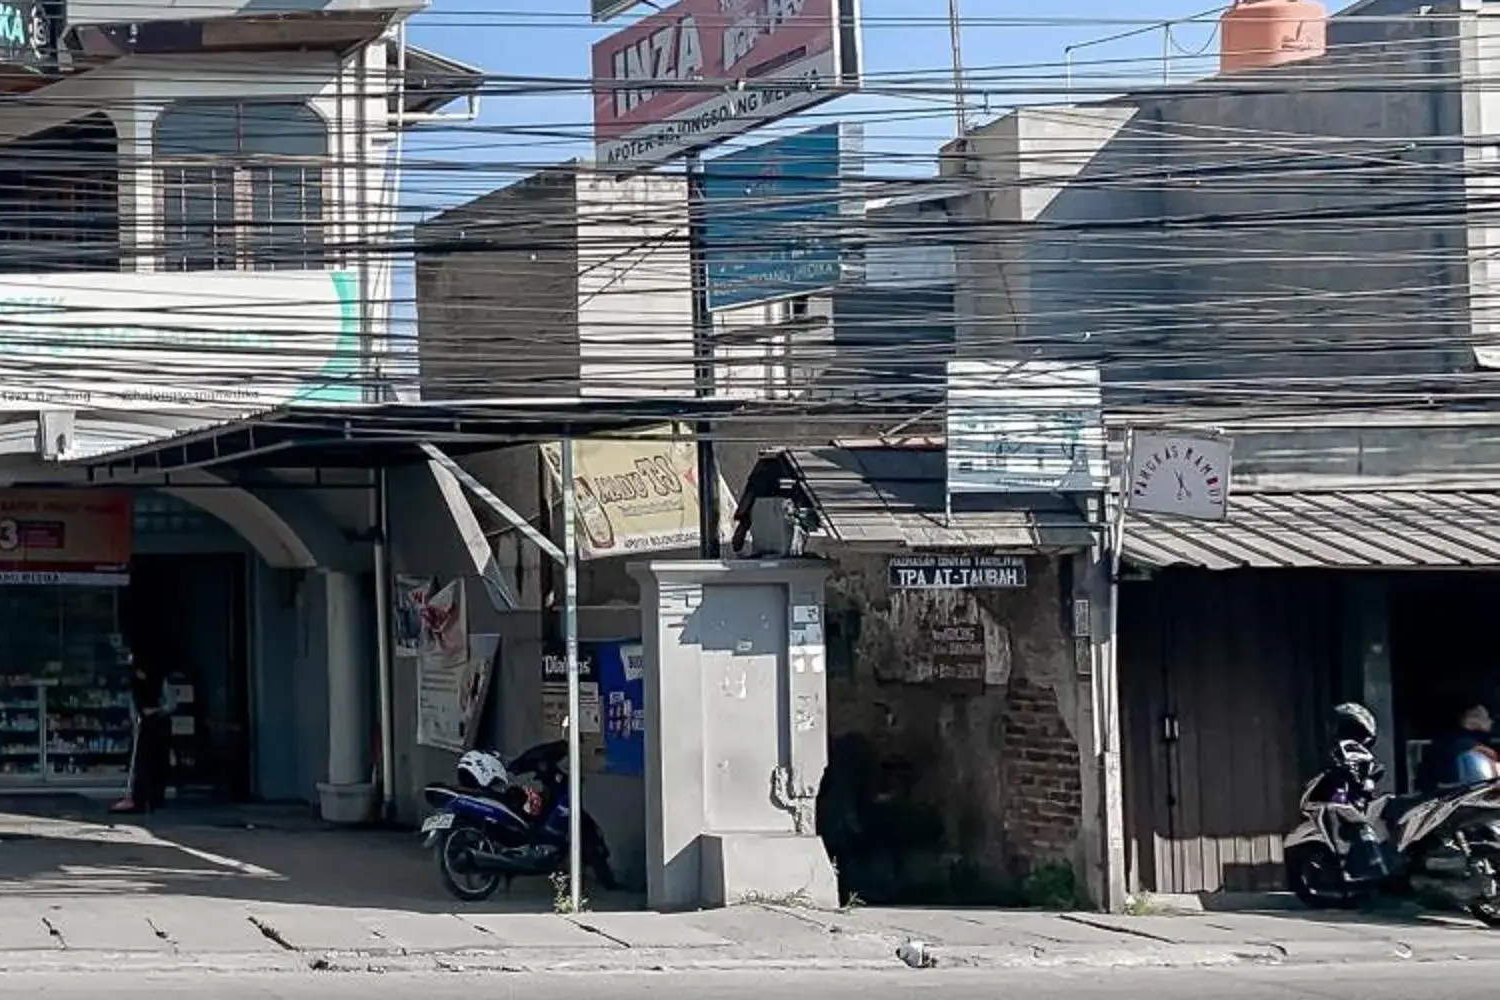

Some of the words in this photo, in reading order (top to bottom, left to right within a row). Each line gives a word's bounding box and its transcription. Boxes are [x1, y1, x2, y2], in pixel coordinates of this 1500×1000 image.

[613, 13, 703, 119] INZA
[897, 569, 927, 586] TPA
[933, 568, 1018, 587] AT-TAUBAH
